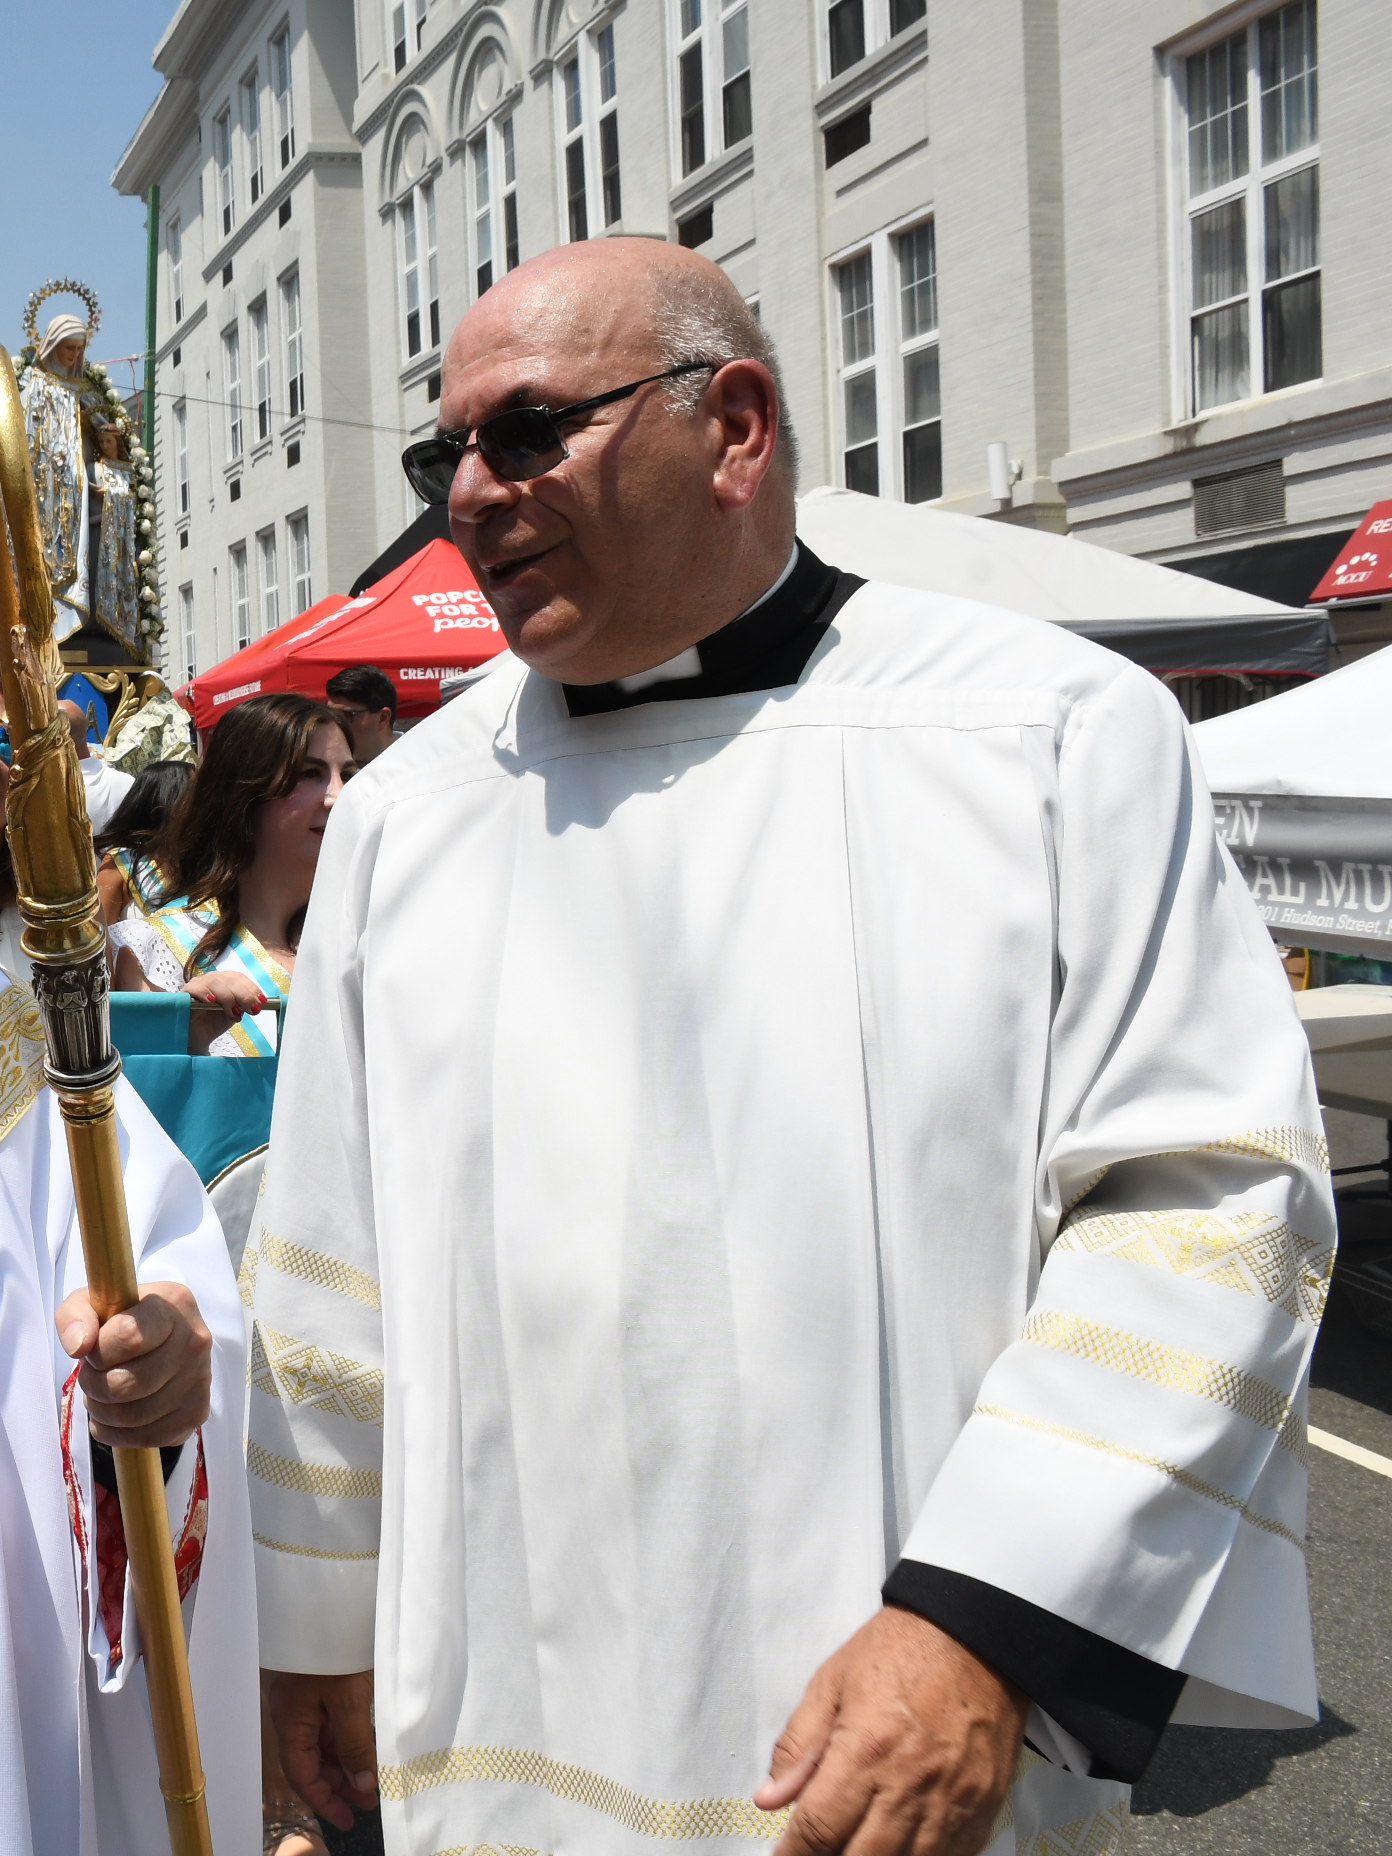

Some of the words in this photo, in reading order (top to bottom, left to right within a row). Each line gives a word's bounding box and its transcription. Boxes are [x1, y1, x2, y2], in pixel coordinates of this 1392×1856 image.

[426, 604, 479, 616] FOR
[400, 667, 463, 679] CREATING
[1235, 854, 1306, 904] AL
[1280, 908, 1334, 928] Hudson
[1336, 914, 1384, 937] Street,
